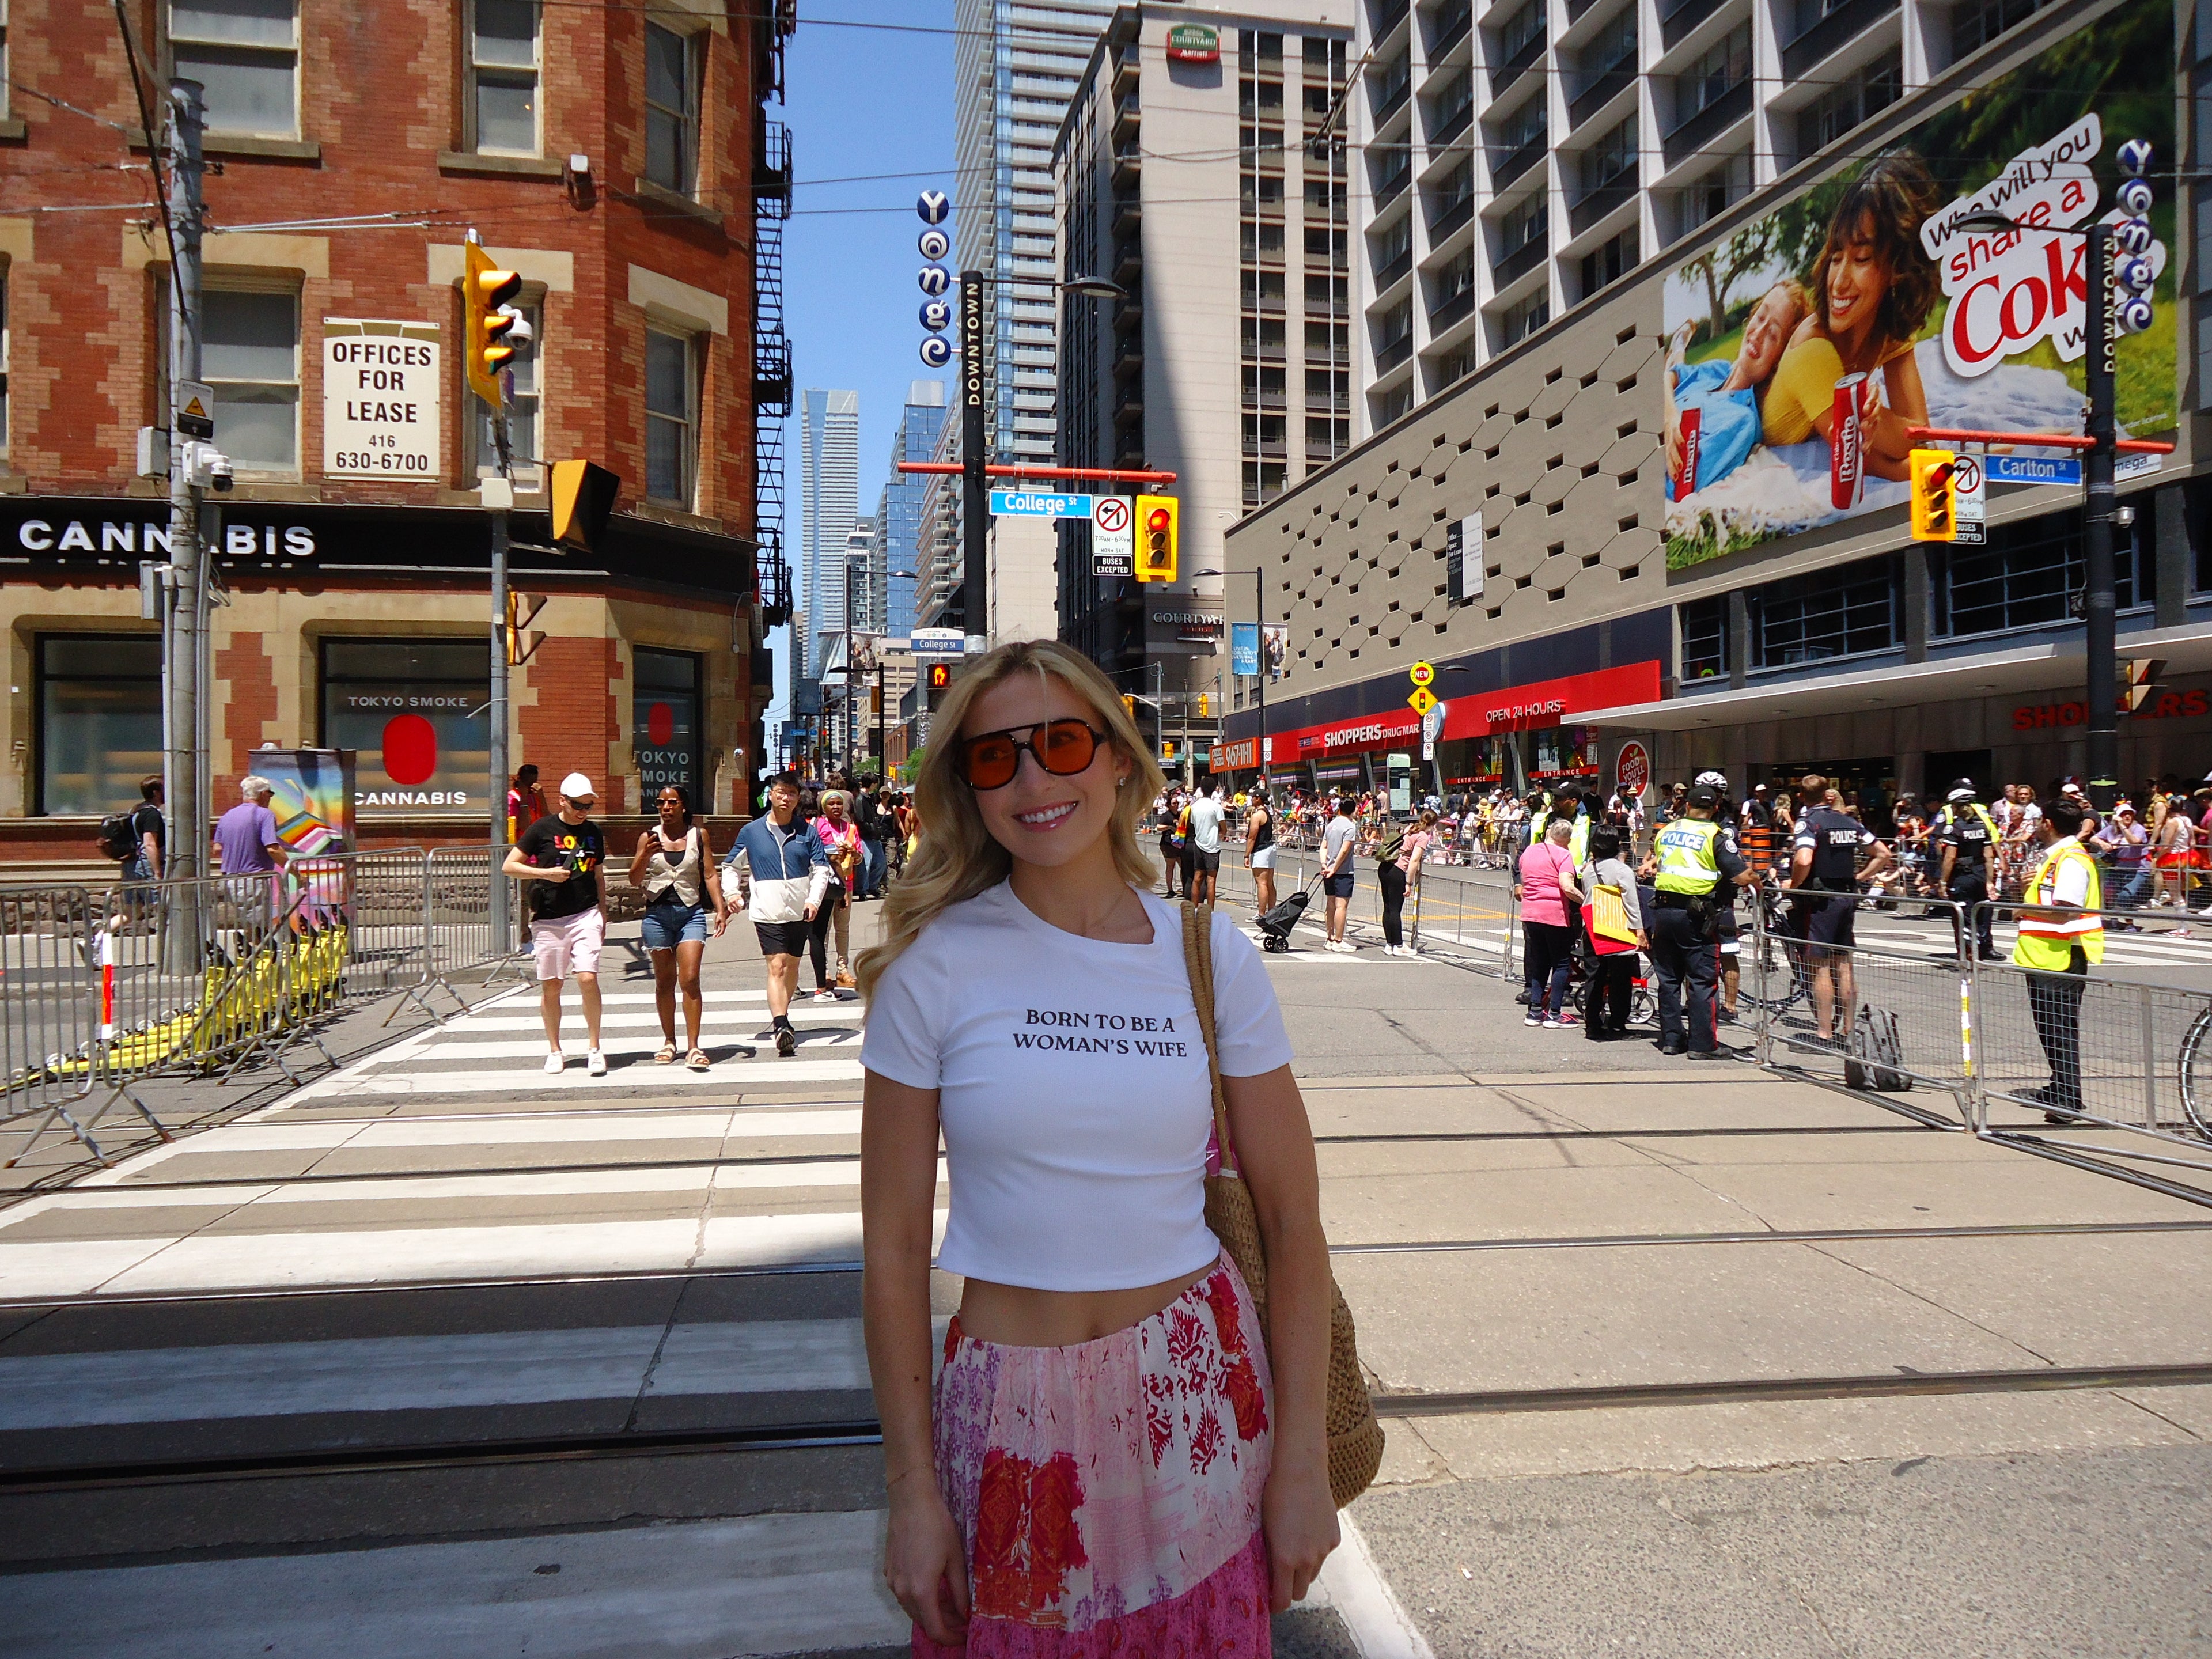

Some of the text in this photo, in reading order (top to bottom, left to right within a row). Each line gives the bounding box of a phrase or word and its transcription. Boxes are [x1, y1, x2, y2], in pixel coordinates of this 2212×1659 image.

[1171, 35, 1216, 47] COURTYARD
[1989, 161, 2035, 207] will
[2041, 128, 2091, 181] you
[2061, 180, 2086, 213] a
[919, 190, 948, 366] Yonge
[1953, 237, 2086, 363] Cok
[2104, 236, 2115, 373] DOWNTOWN
[332, 342, 431, 366] OFFICES
[967, 283, 980, 406] DOWNTOWN
[358, 369, 404, 391] FOR
[347, 400, 417, 423] LEASE
[369, 434, 396, 448] 416
[336, 451, 428, 471] 630-6700
[1999, 457, 2055, 478] Carlton
[1005, 494, 1077, 514] College St
[19, 520, 316, 556] CANNBIS
[1956, 533, 1982, 541] XCEPTED
[919, 640, 948, 650] College
[1415, 671, 1429, 679] NEW
[348, 696, 468, 707] TOKYO SMOKE
[1486, 699, 1561, 722] OPEN 24 HOURS
[1324, 723, 1382, 748] SHOPPERS
[1382, 727, 1402, 739] DRUG
[1402, 723, 1420, 736] MAR
[1544, 768, 1580, 777] ENTRANCE
[1622, 757, 1640, 774] FOOD
[1623, 764, 1645, 783] YOU'LL
[641, 770, 690, 783] MOKE
[1628, 775, 1642, 787] OVE
[354, 791, 467, 805] CANNABIS
[1661, 832, 1705, 850] POLICE
[1829, 830, 1858, 844] POLICE
[1963, 829, 1986, 839] POLICE
[1025, 1009, 1175, 1033] BORN TO BE A
[1013, 1033, 1187, 1058] WOMAN'S WIFE
